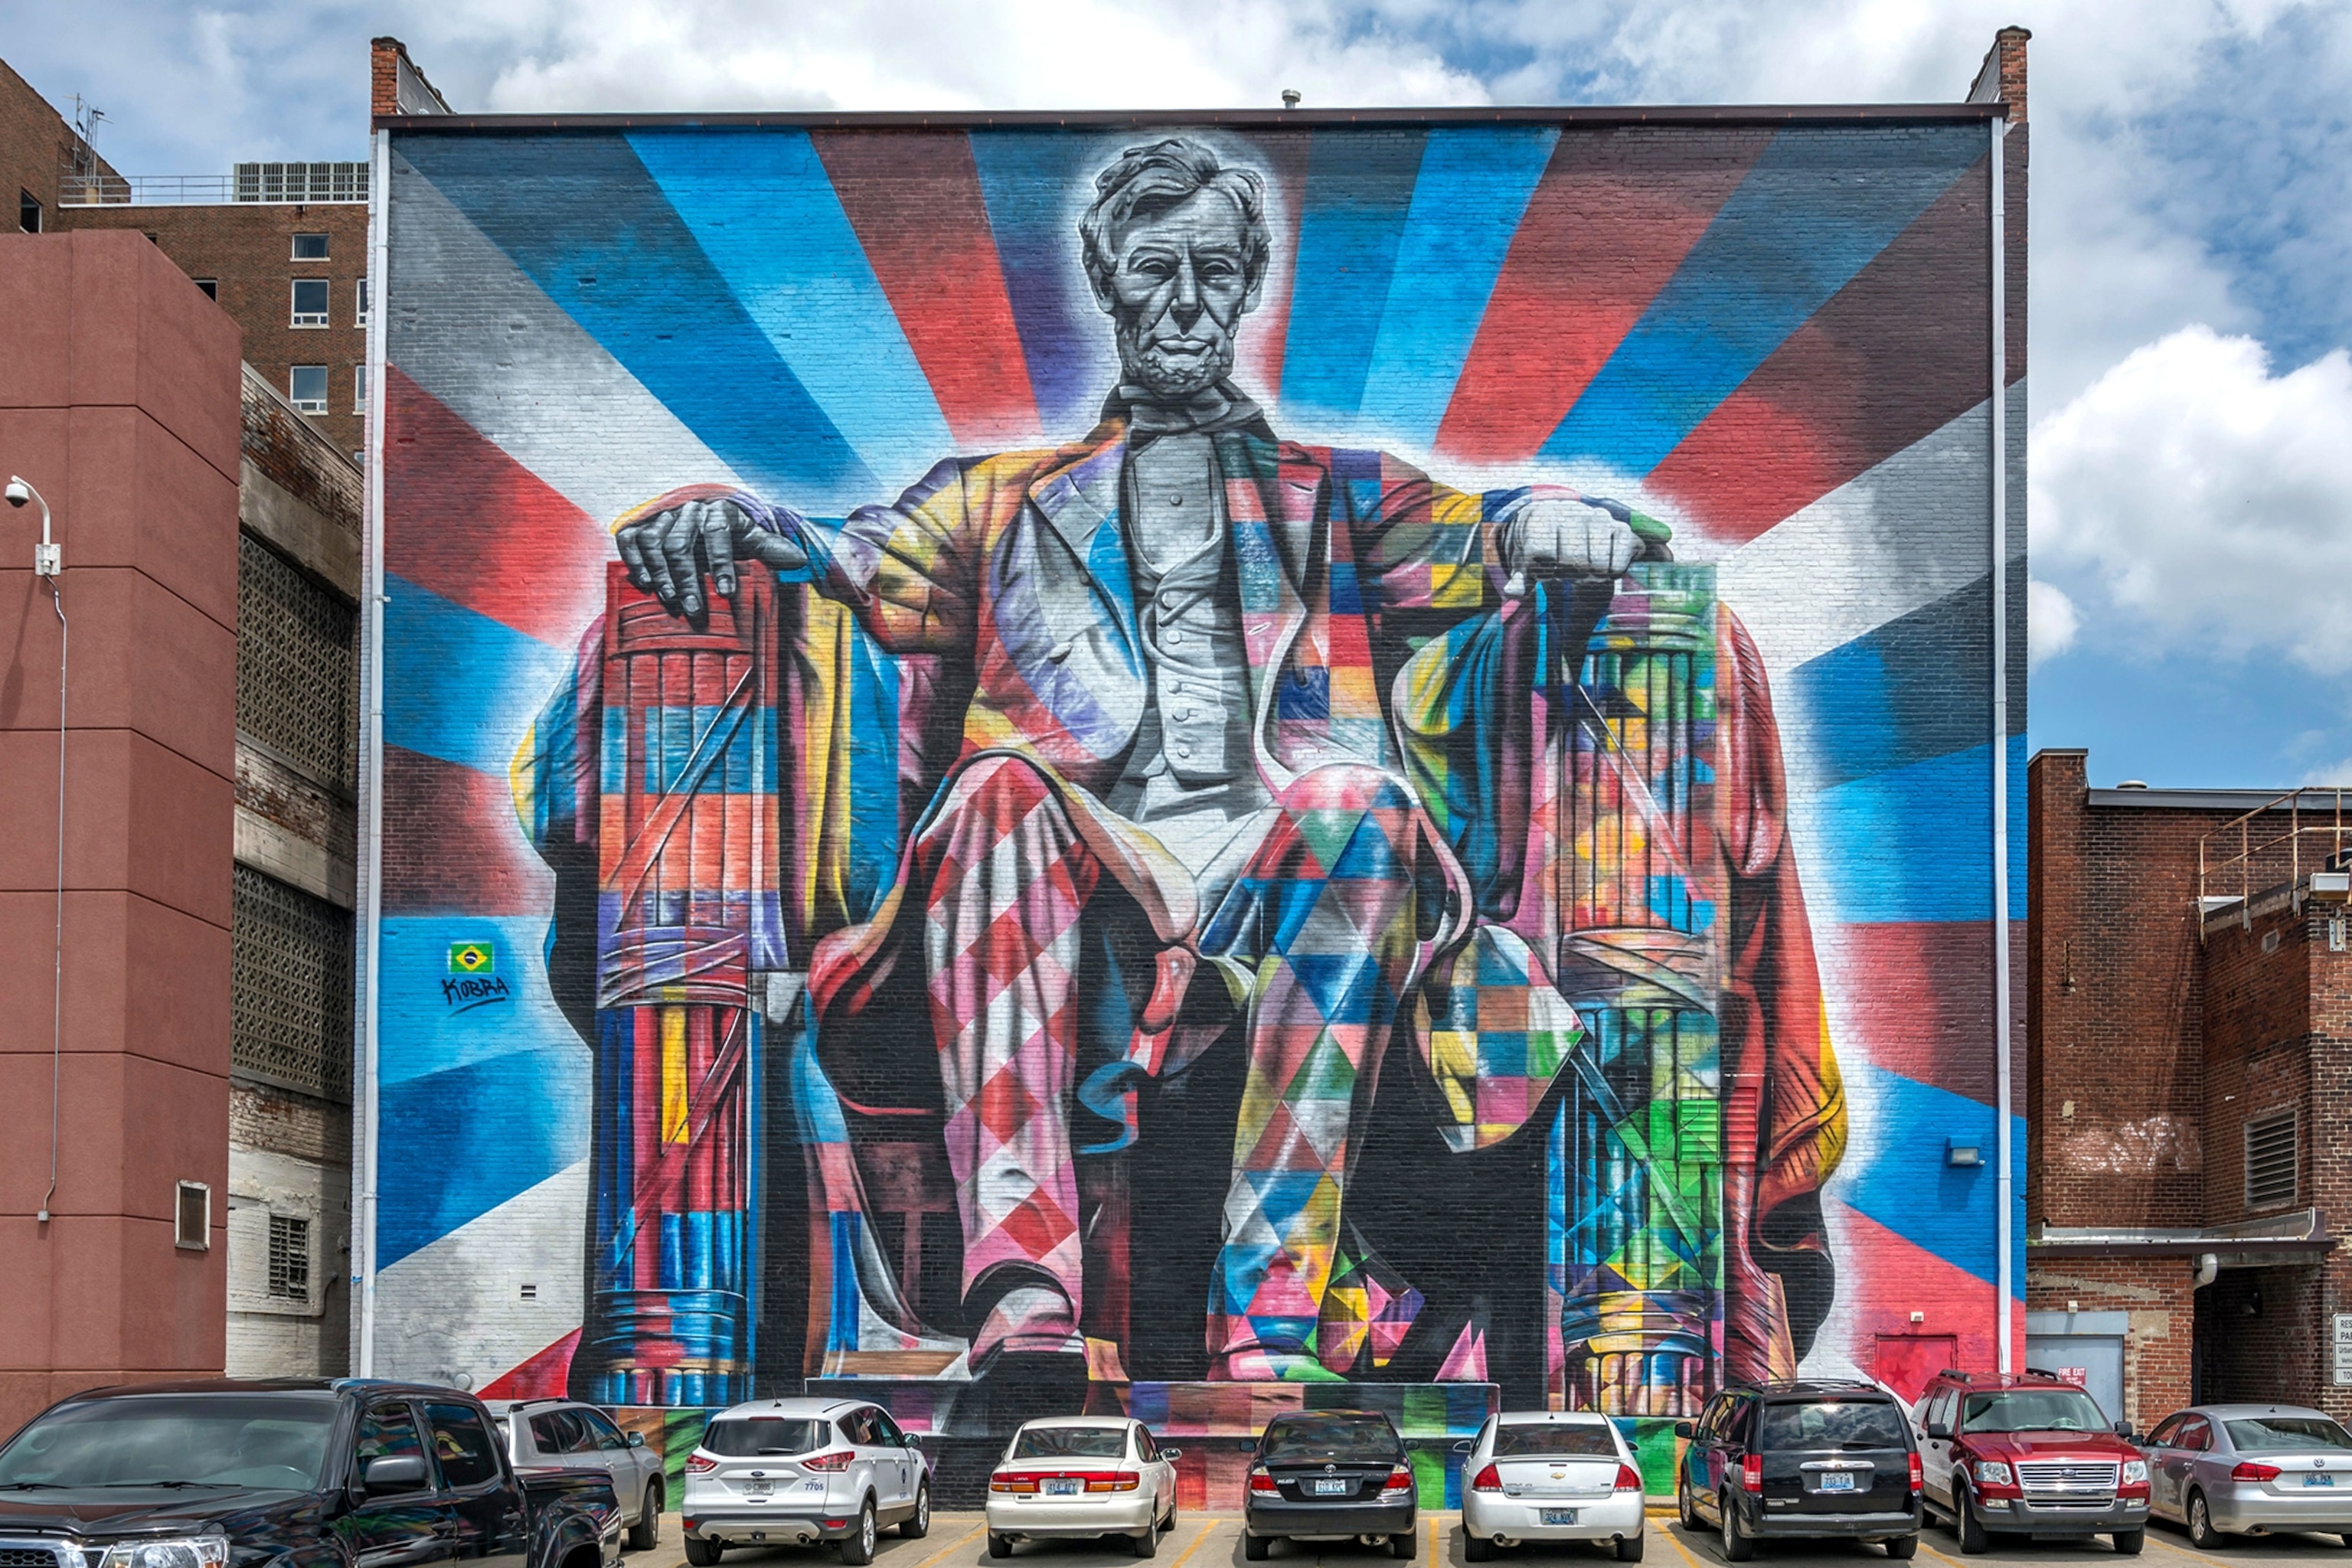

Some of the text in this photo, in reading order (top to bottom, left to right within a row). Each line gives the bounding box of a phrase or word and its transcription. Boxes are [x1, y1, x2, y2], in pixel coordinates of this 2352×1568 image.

[441, 977, 509, 1005] KOBRA
[2058, 1367, 2086, 1376] FIRE EXIT
[805, 1482, 824, 1491] 7705
